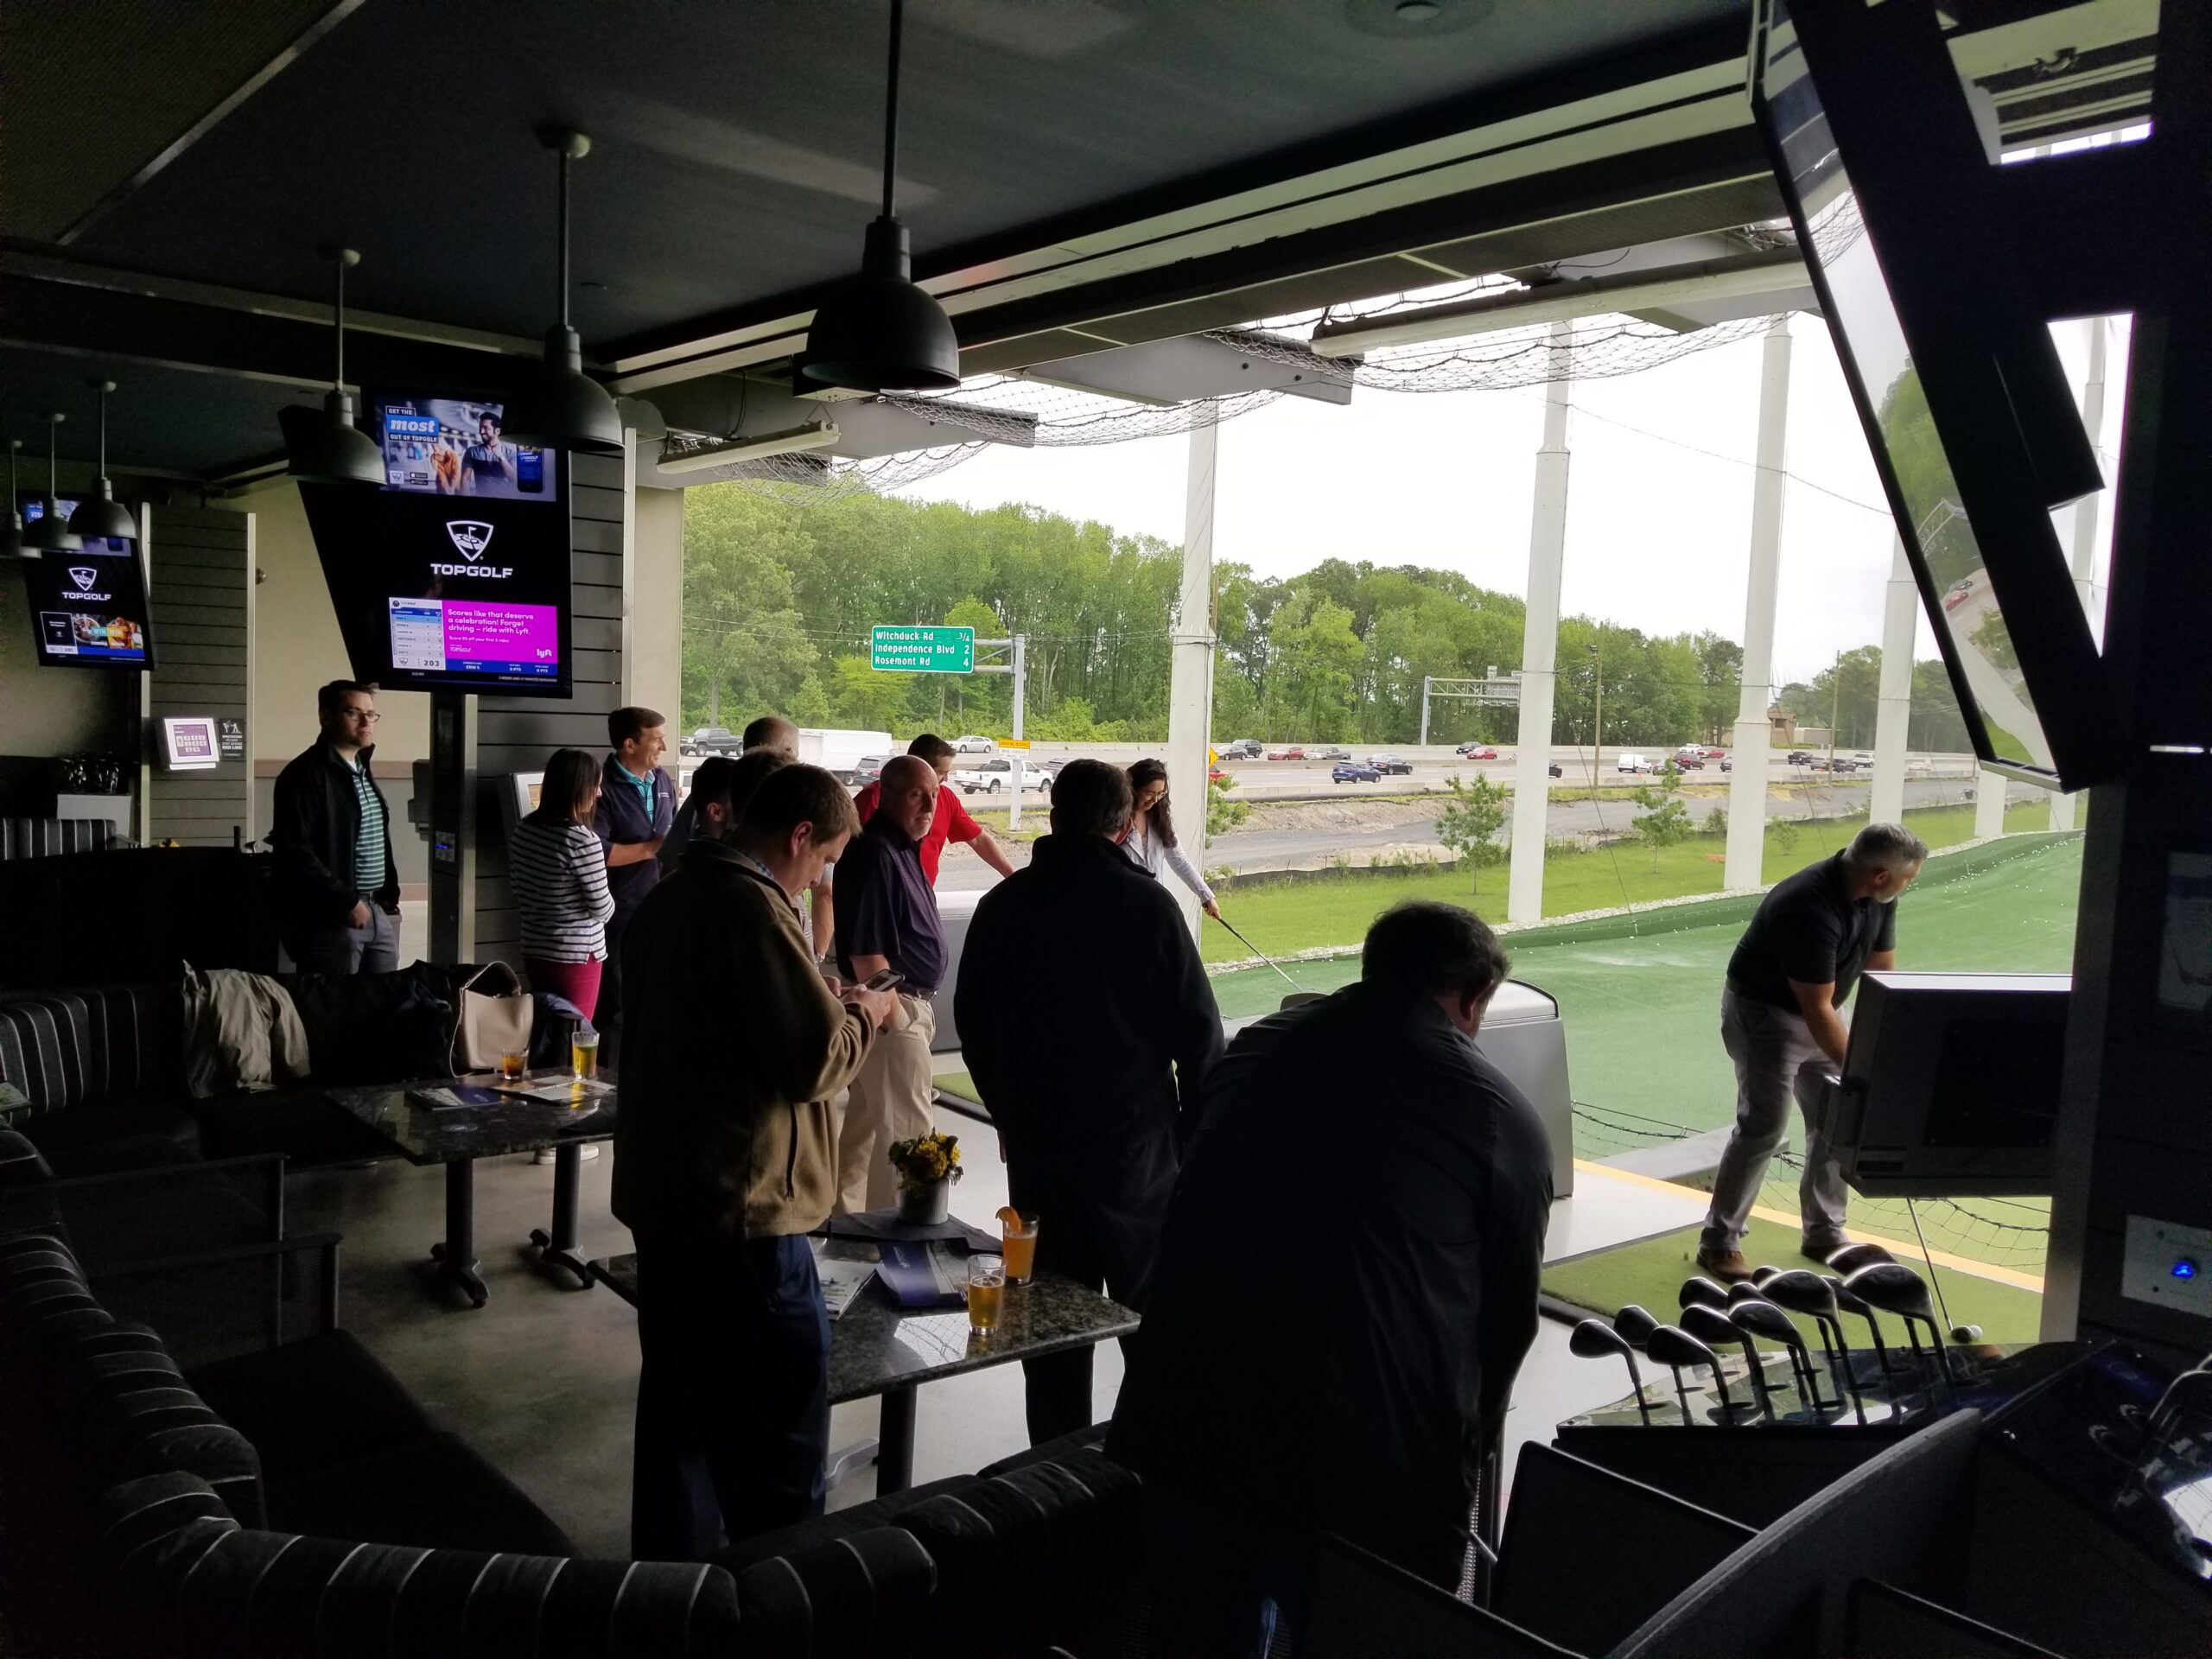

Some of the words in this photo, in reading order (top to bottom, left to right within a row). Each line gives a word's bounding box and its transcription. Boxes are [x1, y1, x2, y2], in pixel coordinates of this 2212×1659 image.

[391, 420, 435, 433] most
[430, 563, 513, 578] TOPGOLF
[61, 592, 111, 601] TOPGOLF
[448, 608, 473, 617] Scores
[454, 617, 499, 626] celebration!
[500, 620, 524, 628] Forget
[448, 624, 474, 633] driving
[875, 631, 919, 641] Witchduck
[923, 632, 934, 641] Rd
[875, 644, 933, 655] Independence
[937, 645, 955, 654] Blvd
[963, 645, 969, 655] 2
[874, 656, 916, 666] Rosemont
[919, 657, 931, 666] Rd
[963, 658, 969, 667] 4
